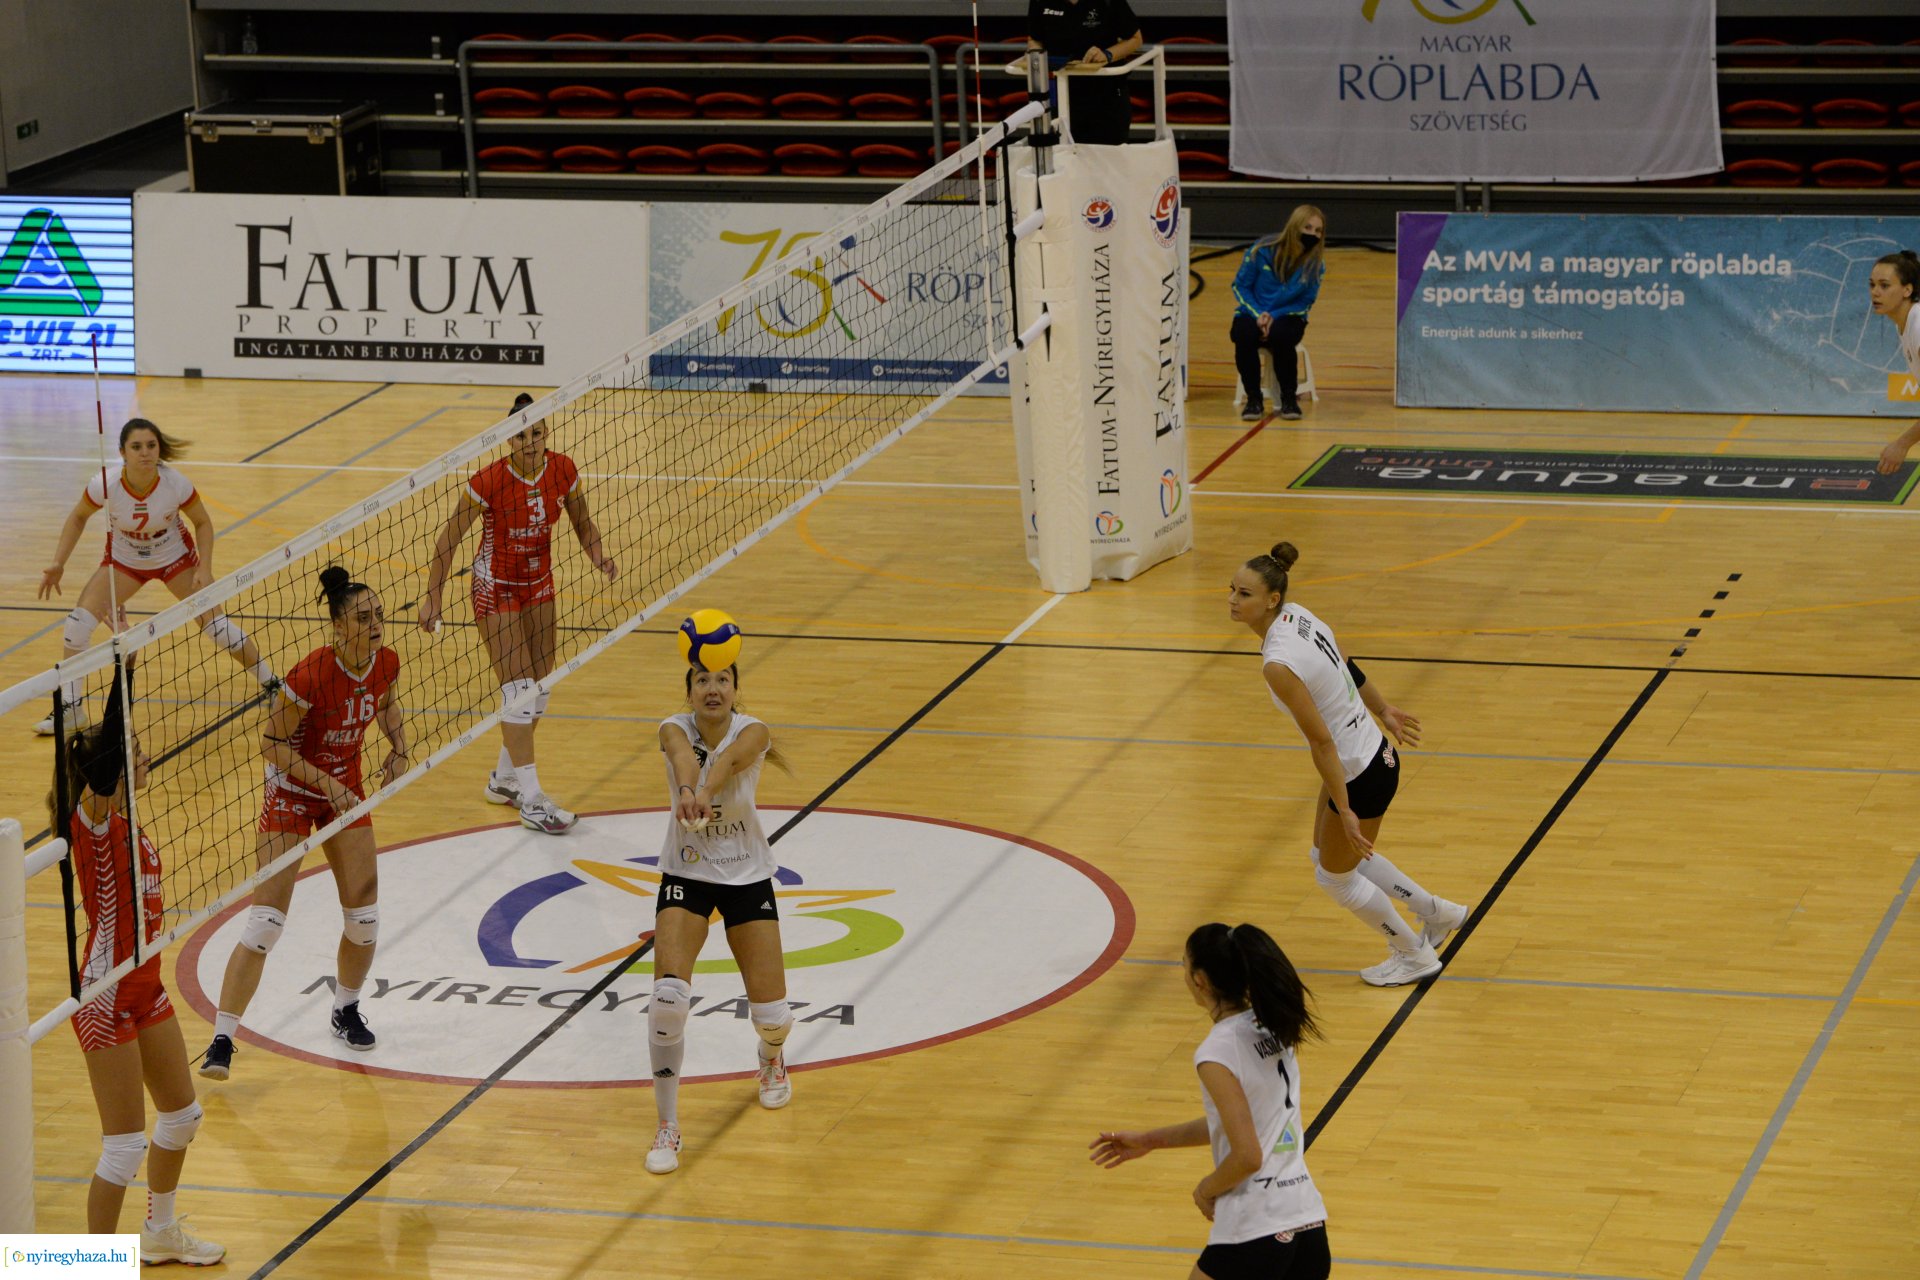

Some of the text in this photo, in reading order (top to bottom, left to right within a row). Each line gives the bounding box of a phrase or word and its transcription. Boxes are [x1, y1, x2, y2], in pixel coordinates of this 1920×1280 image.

[1420, 35, 1512, 52] MAGYAR
[1338, 55, 1600, 101] RÖPLABDA
[1409, 110, 1527, 132] SZÖVETSÉG
[235, 216, 544, 316] FATUM
[1423, 250, 1793, 280] Az MVM a magyar röplabda
[907, 265, 1003, 304] RÖPL
[1422, 280, 1686, 311] sportág támogatója
[237, 314, 542, 340] PROPERTY
[1421, 326, 1584, 341] Energiát adunk a sikerhez
[238, 342, 541, 362] INGATLANBERUHÁZÓ KFT
[1154, 271, 1175, 446] FATUM
[133, 512, 150, 532] 7
[527, 496, 546, 523] 3
[1314, 630, 1340, 670] 11
[342, 693, 376, 727] 16
[141, 837, 159, 867] 9
[664, 885, 684, 901] 15
[1277, 1058, 1295, 1110] 1
